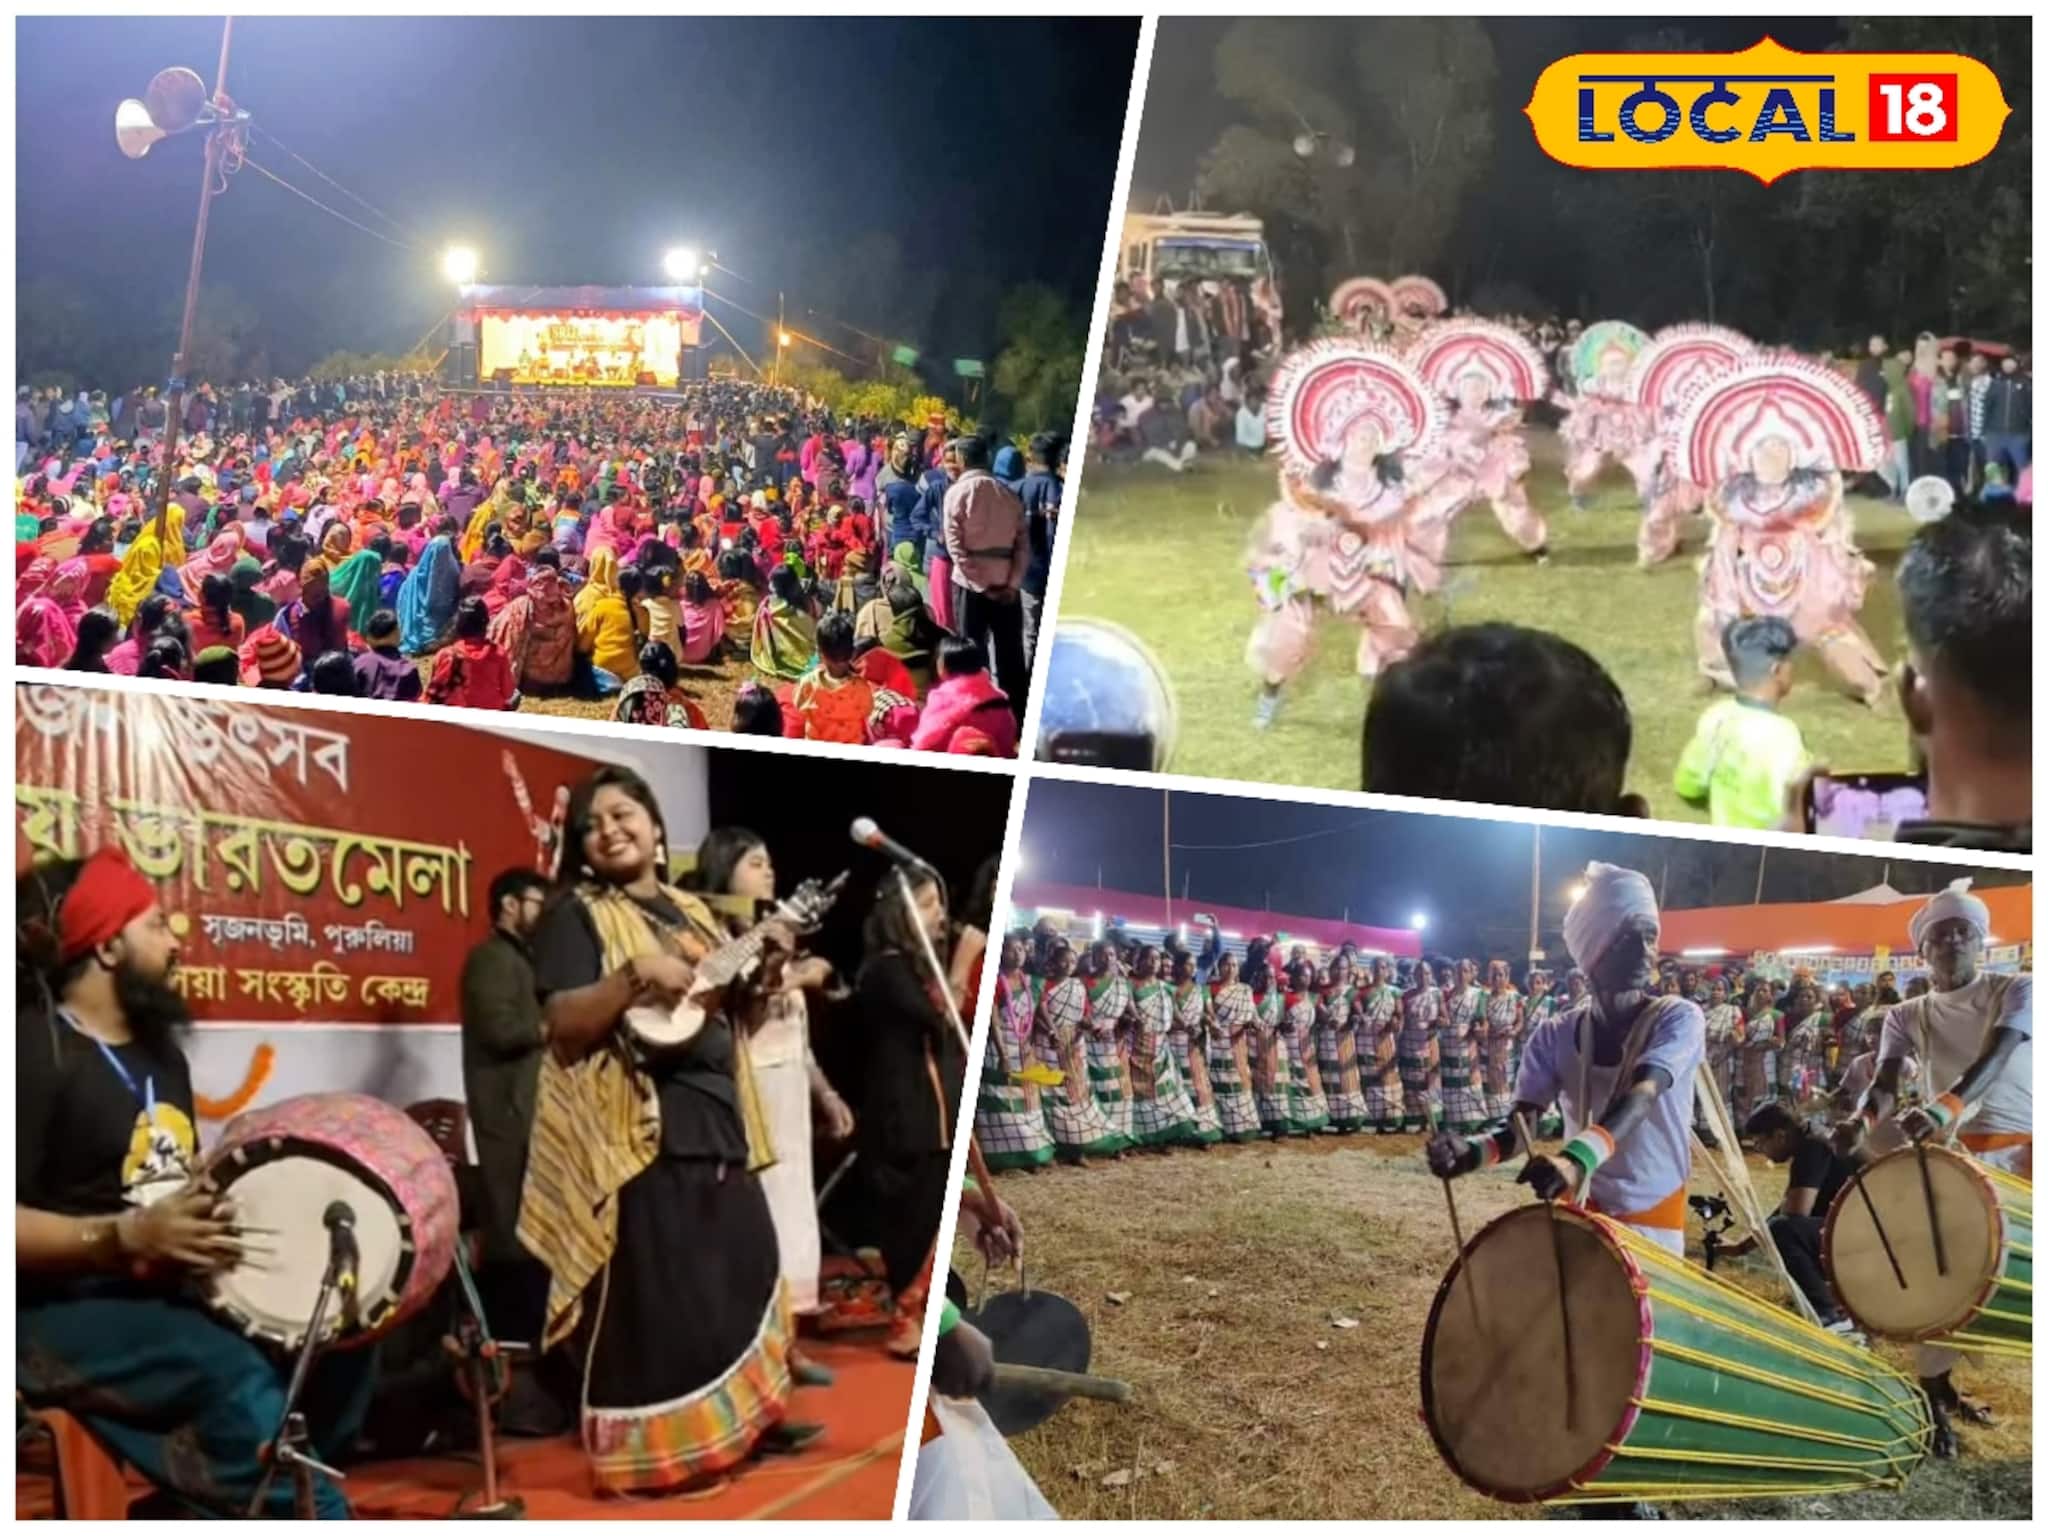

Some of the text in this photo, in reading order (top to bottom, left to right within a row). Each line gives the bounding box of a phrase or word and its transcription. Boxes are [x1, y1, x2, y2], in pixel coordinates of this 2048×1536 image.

[108, 798, 472, 918] ভারতমেলা
[237, 960, 350, 1012] সংস্কৃতি
[360, 974, 430, 1007] কেন্দ্র
